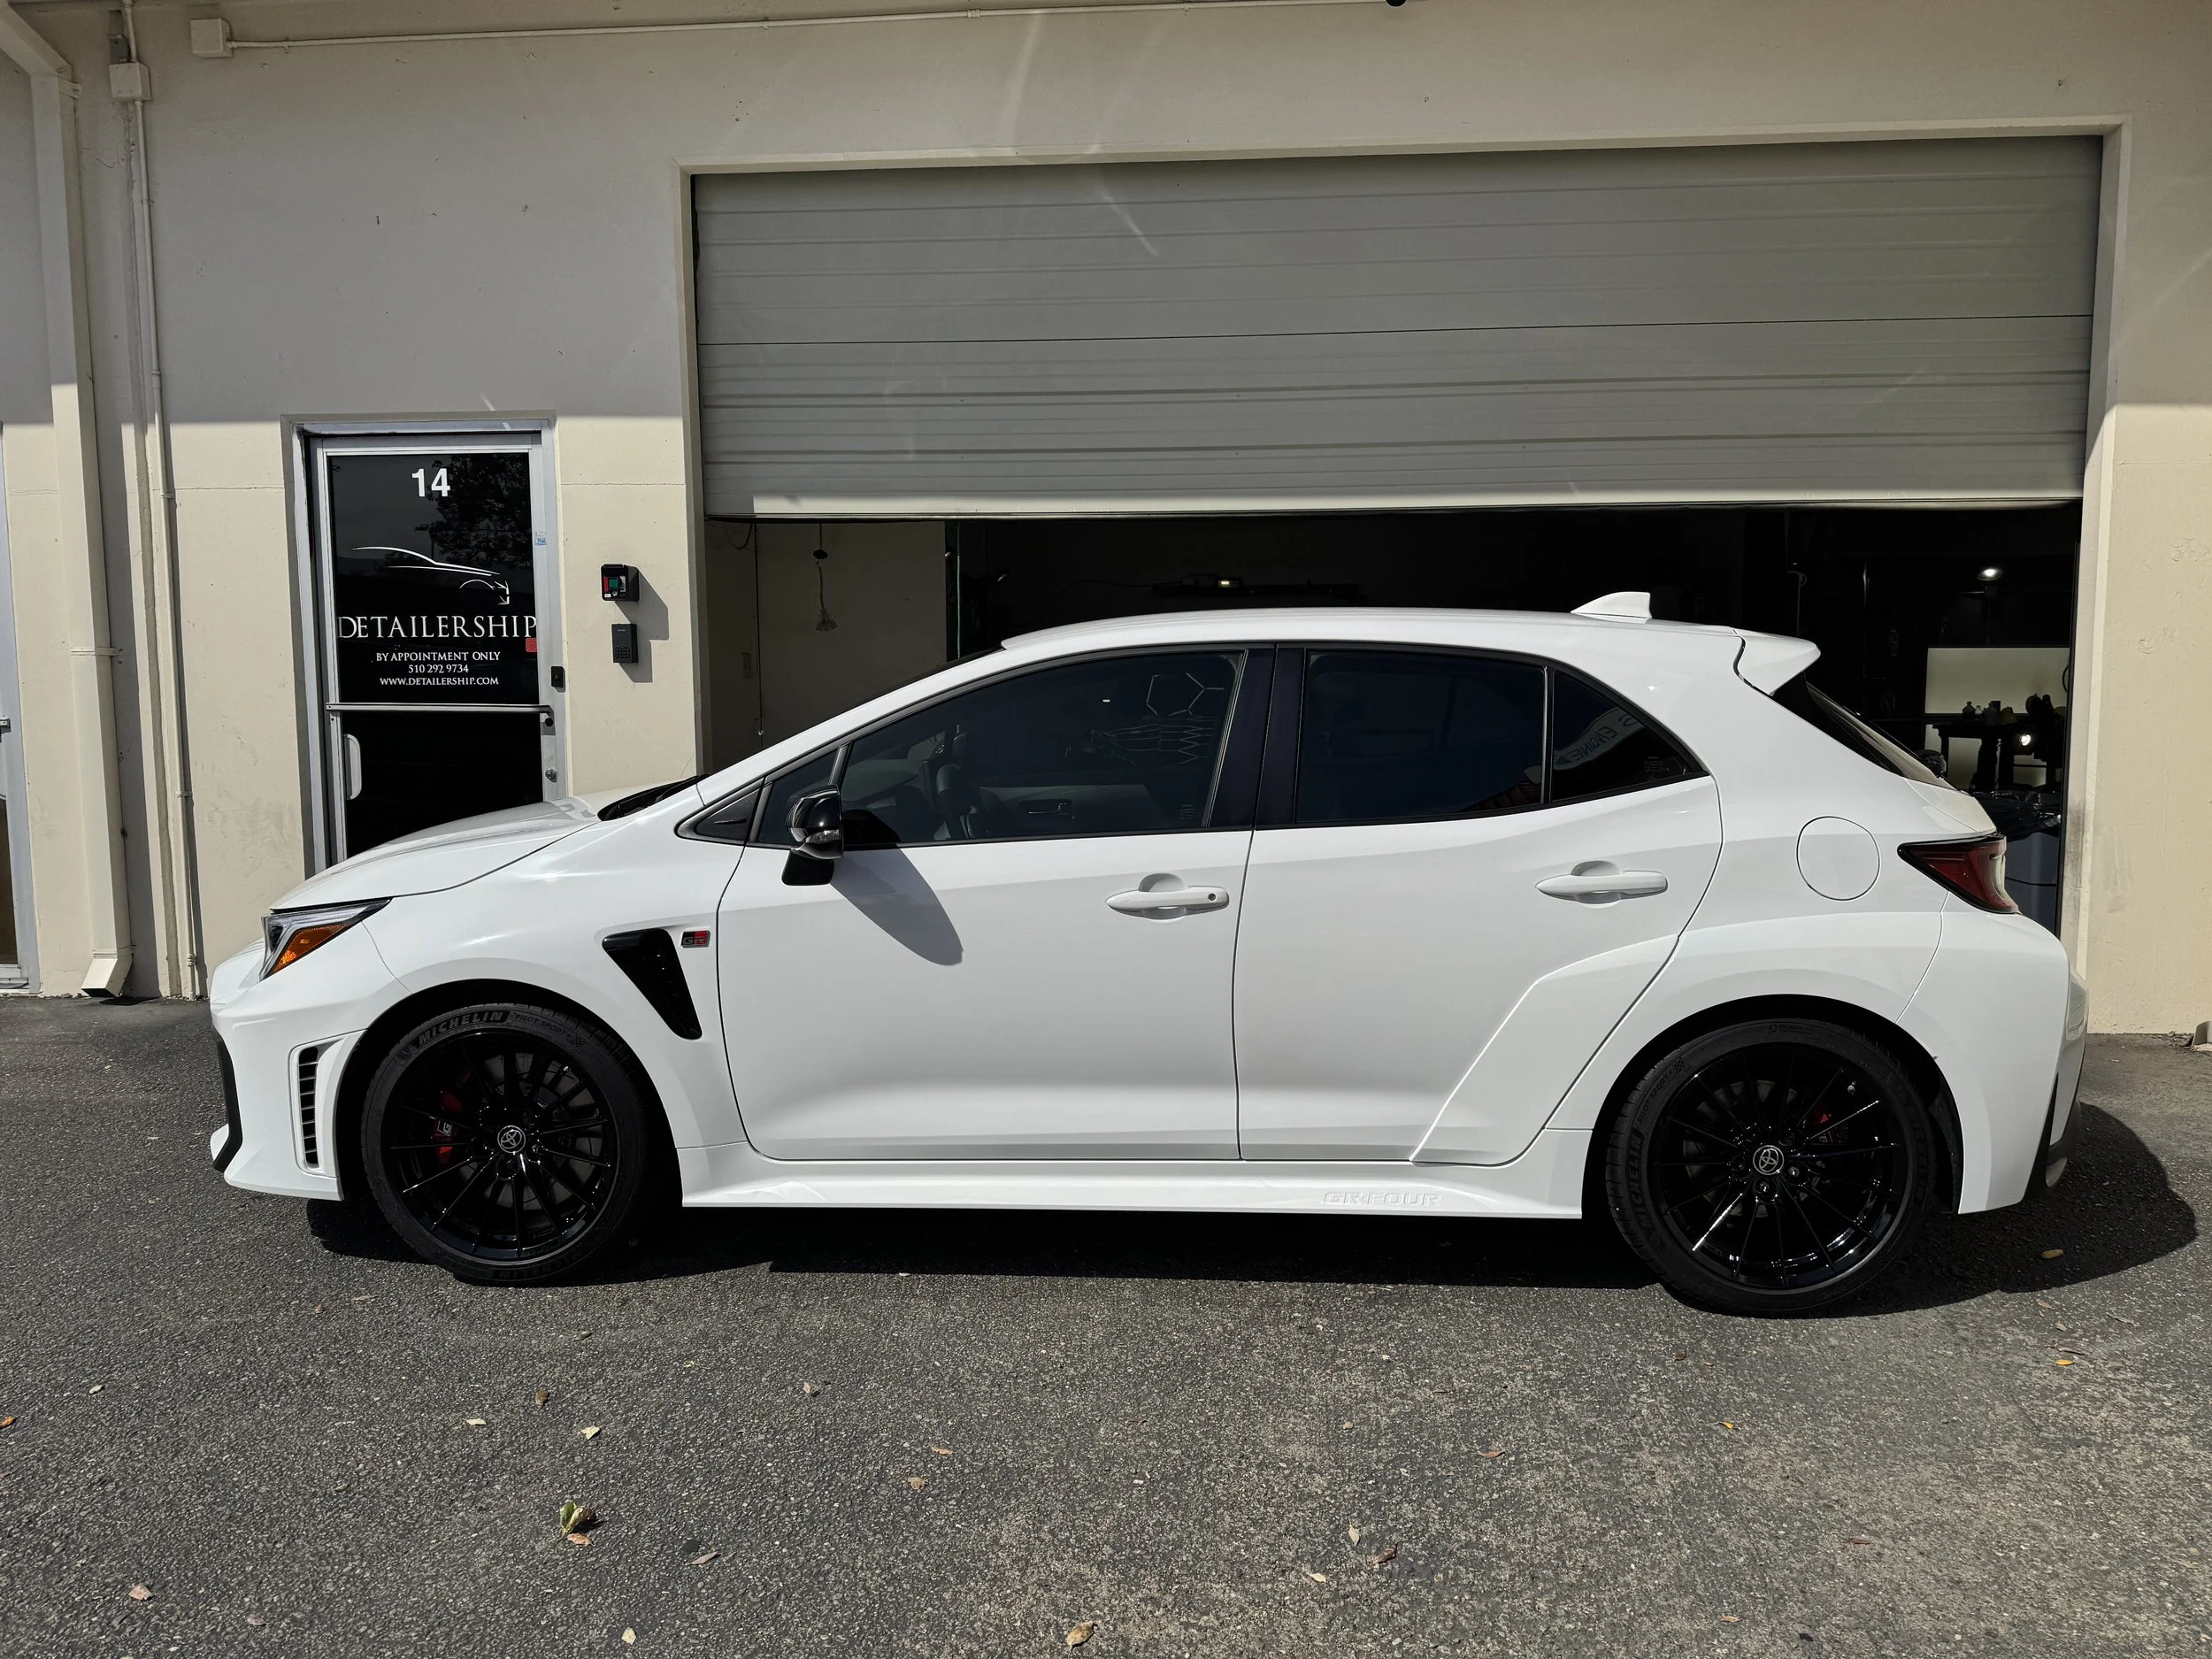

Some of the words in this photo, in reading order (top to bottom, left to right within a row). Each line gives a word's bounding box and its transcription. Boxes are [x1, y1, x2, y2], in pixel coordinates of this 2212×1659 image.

[411, 468, 450, 497] 14
[337, 616, 537, 639] DETAILERSHIP
[376, 652, 389, 662] BY
[391, 651, 469, 662] APPOINTMENT
[472, 651, 501, 662] ONLY
[408, 664, 425, 673] 510
[427, 664, 444, 673] 292
[446, 664, 469, 673] 9734
[380, 677, 499, 687] WWW.DETAILERSHIP.COM
[682, 936, 707, 946] GR
[419, 1011, 504, 1045] MICHELIN
[515, 1014, 540, 1025] PILOT
[540, 1021, 567, 1035] SPORT
[1638, 1100, 1652, 1124] PILOT
[1649, 1076, 1669, 1100] SPORT
[1627, 1133, 1652, 1229] MICHELIN
